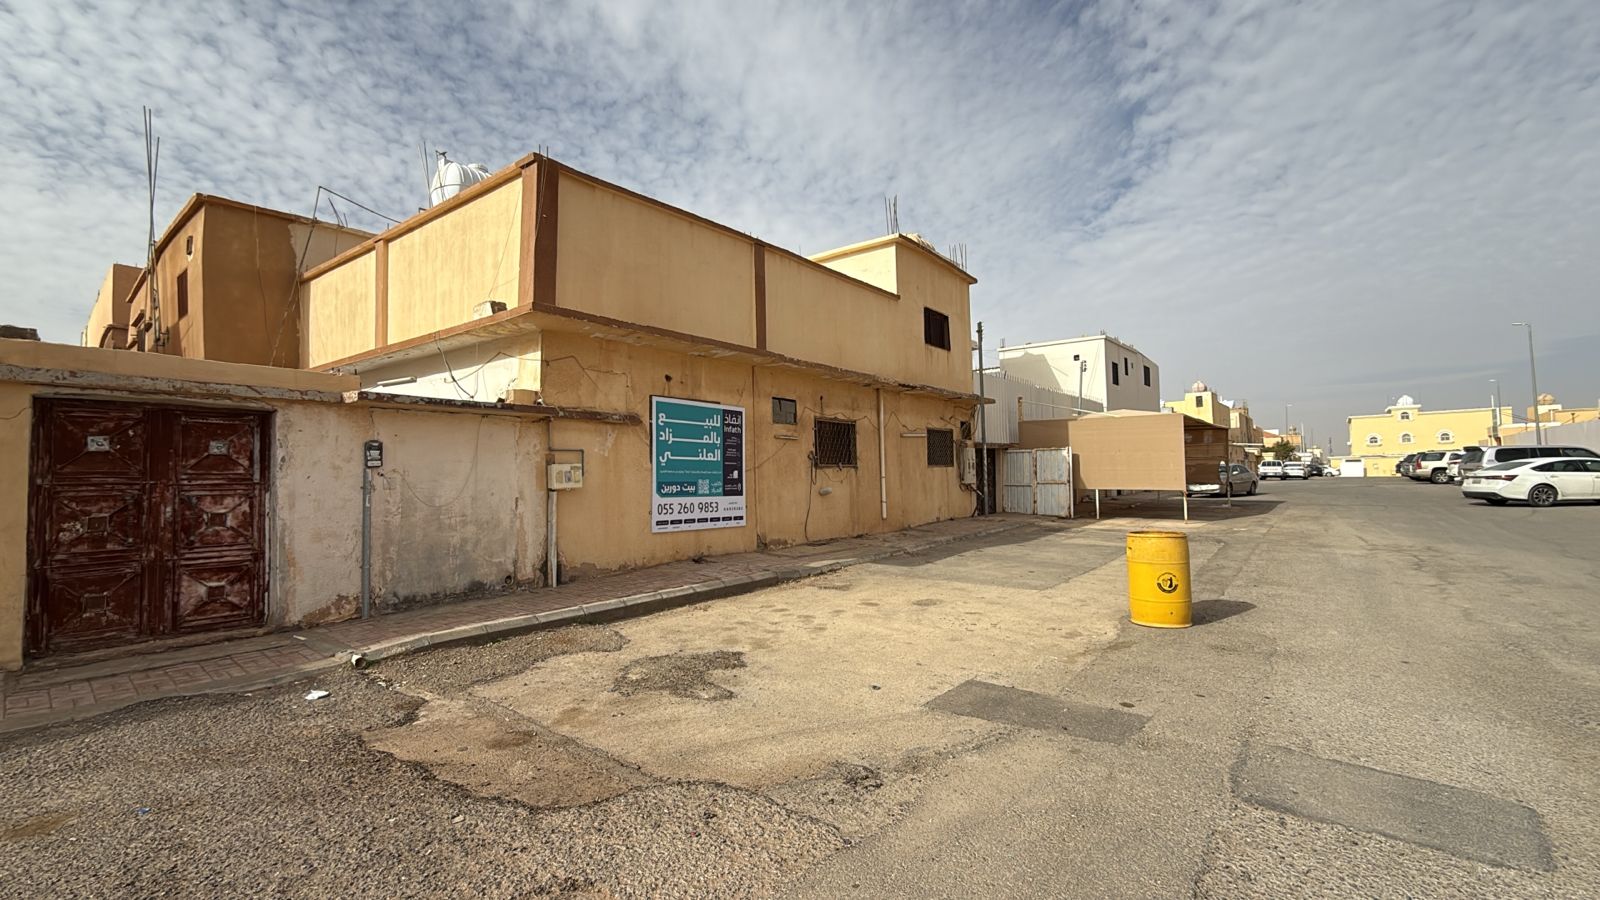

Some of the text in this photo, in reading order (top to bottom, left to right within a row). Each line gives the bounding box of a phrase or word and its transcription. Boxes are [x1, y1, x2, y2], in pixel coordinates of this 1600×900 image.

[724, 425, 742, 434] Infath
[659, 427, 720, 447] بالمزاد
[659, 448, 720, 466] العلني
[682, 483, 696, 493] بيت
[657, 503, 674, 515] 055
[677, 502, 695, 514] 260
[697, 501, 719, 513] 9853
